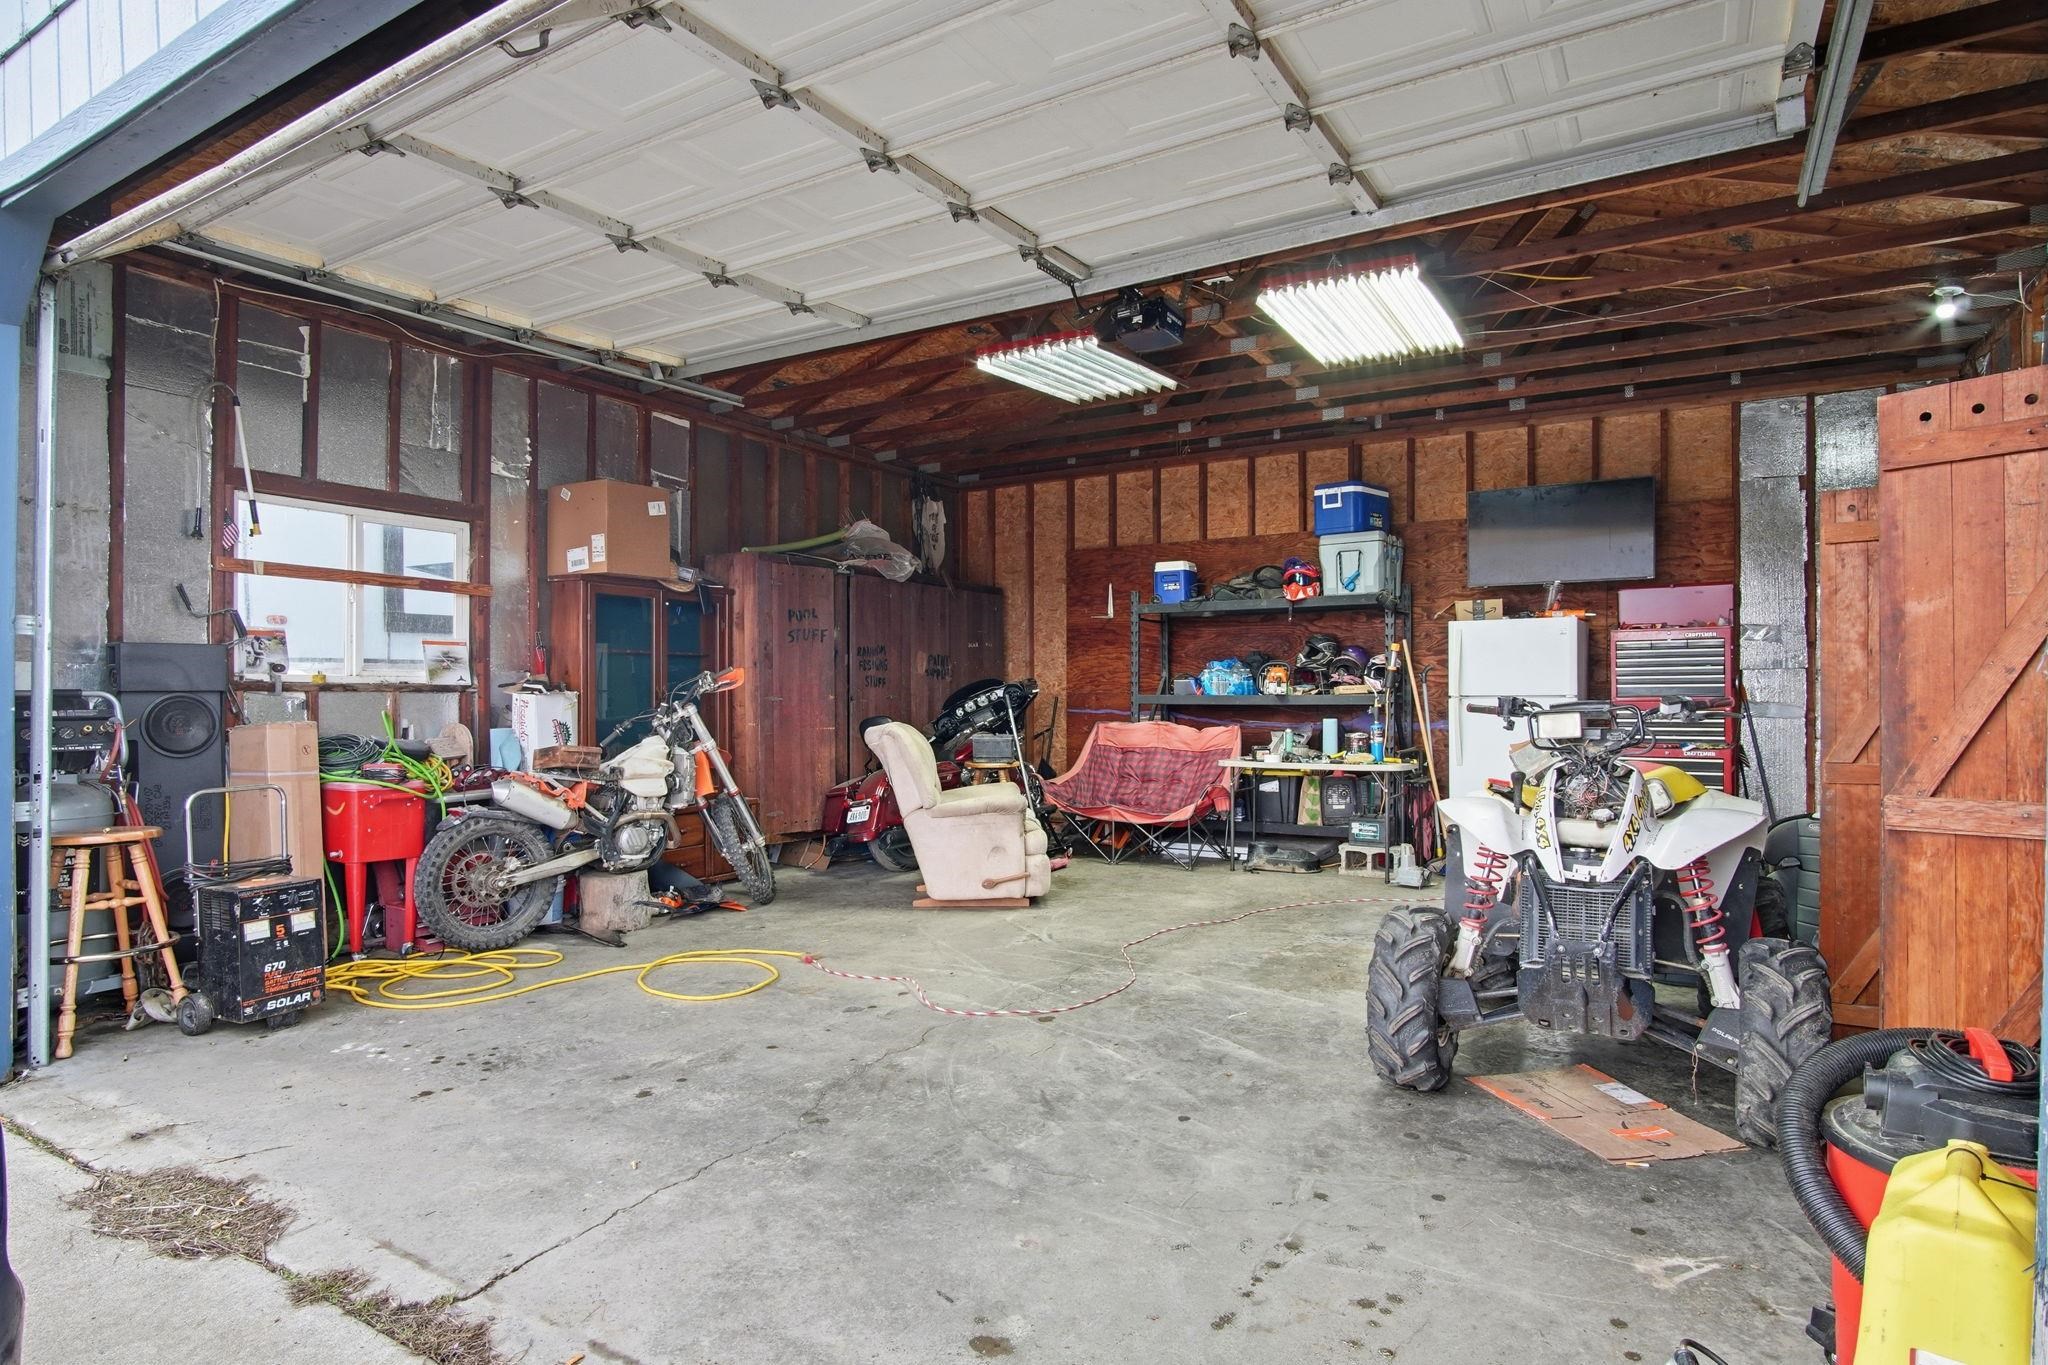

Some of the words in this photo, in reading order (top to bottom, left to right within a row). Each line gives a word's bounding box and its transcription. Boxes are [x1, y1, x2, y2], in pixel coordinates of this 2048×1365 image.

[788, 608, 818, 623] POOL
[787, 628, 828, 643] STUFF
[864, 675, 887, 688] STUFF
[275, 923, 285, 935] 5
[264, 960, 286, 973] 670
[264, 974, 292, 985] BATTERY
[266, 992, 311, 1011] SOLAR
